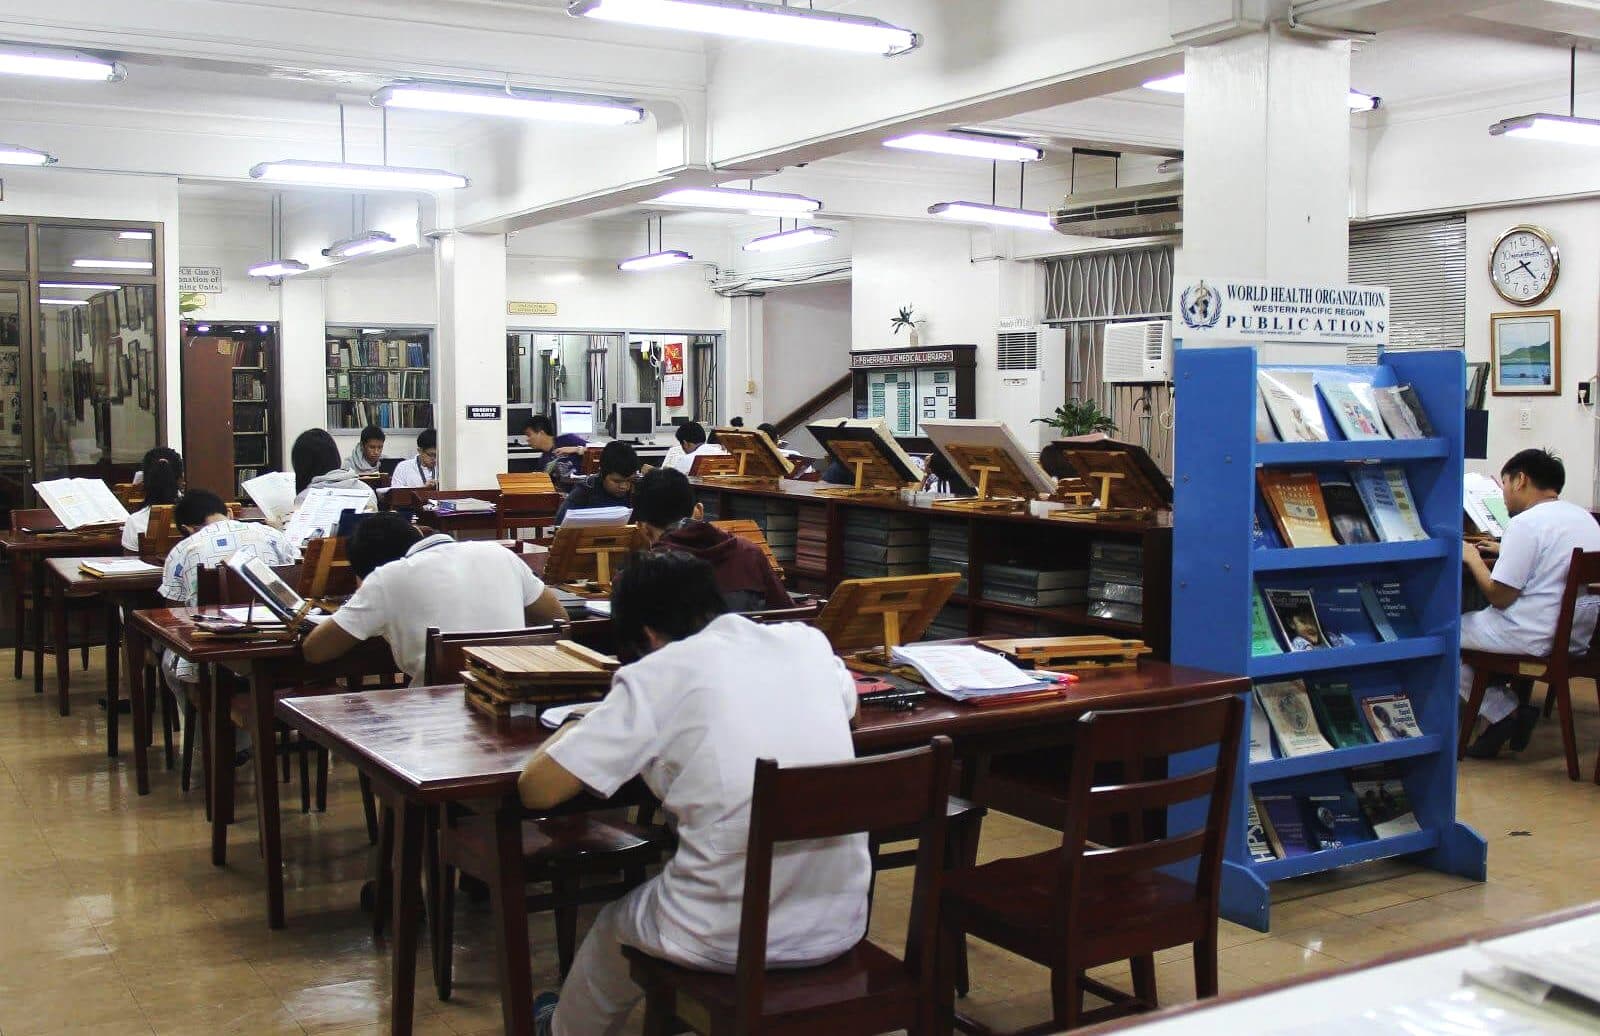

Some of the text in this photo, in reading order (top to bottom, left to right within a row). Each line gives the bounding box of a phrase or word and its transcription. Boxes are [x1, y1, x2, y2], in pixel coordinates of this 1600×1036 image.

[1510, 241, 1517, 250] 11
[1519, 236, 1527, 246] 12
[1539, 246, 1545, 255] 2
[1500, 262, 1506, 272] 9
[1544, 259, 1549, 268] 3
[1504, 273, 1510, 284] 8
[1540, 272, 1546, 281] 4
[1513, 282, 1519, 292] 7
[1523, 284, 1529, 294] 6
[1533, 281, 1539, 290] 5
[1227, 284, 1385, 307] WORLD HEALTH ORGANIZATION
[1253, 305, 1365, 316] WESTERN PACIFIC REGION
[1226, 315, 1385, 333] PUBLICATIONS
